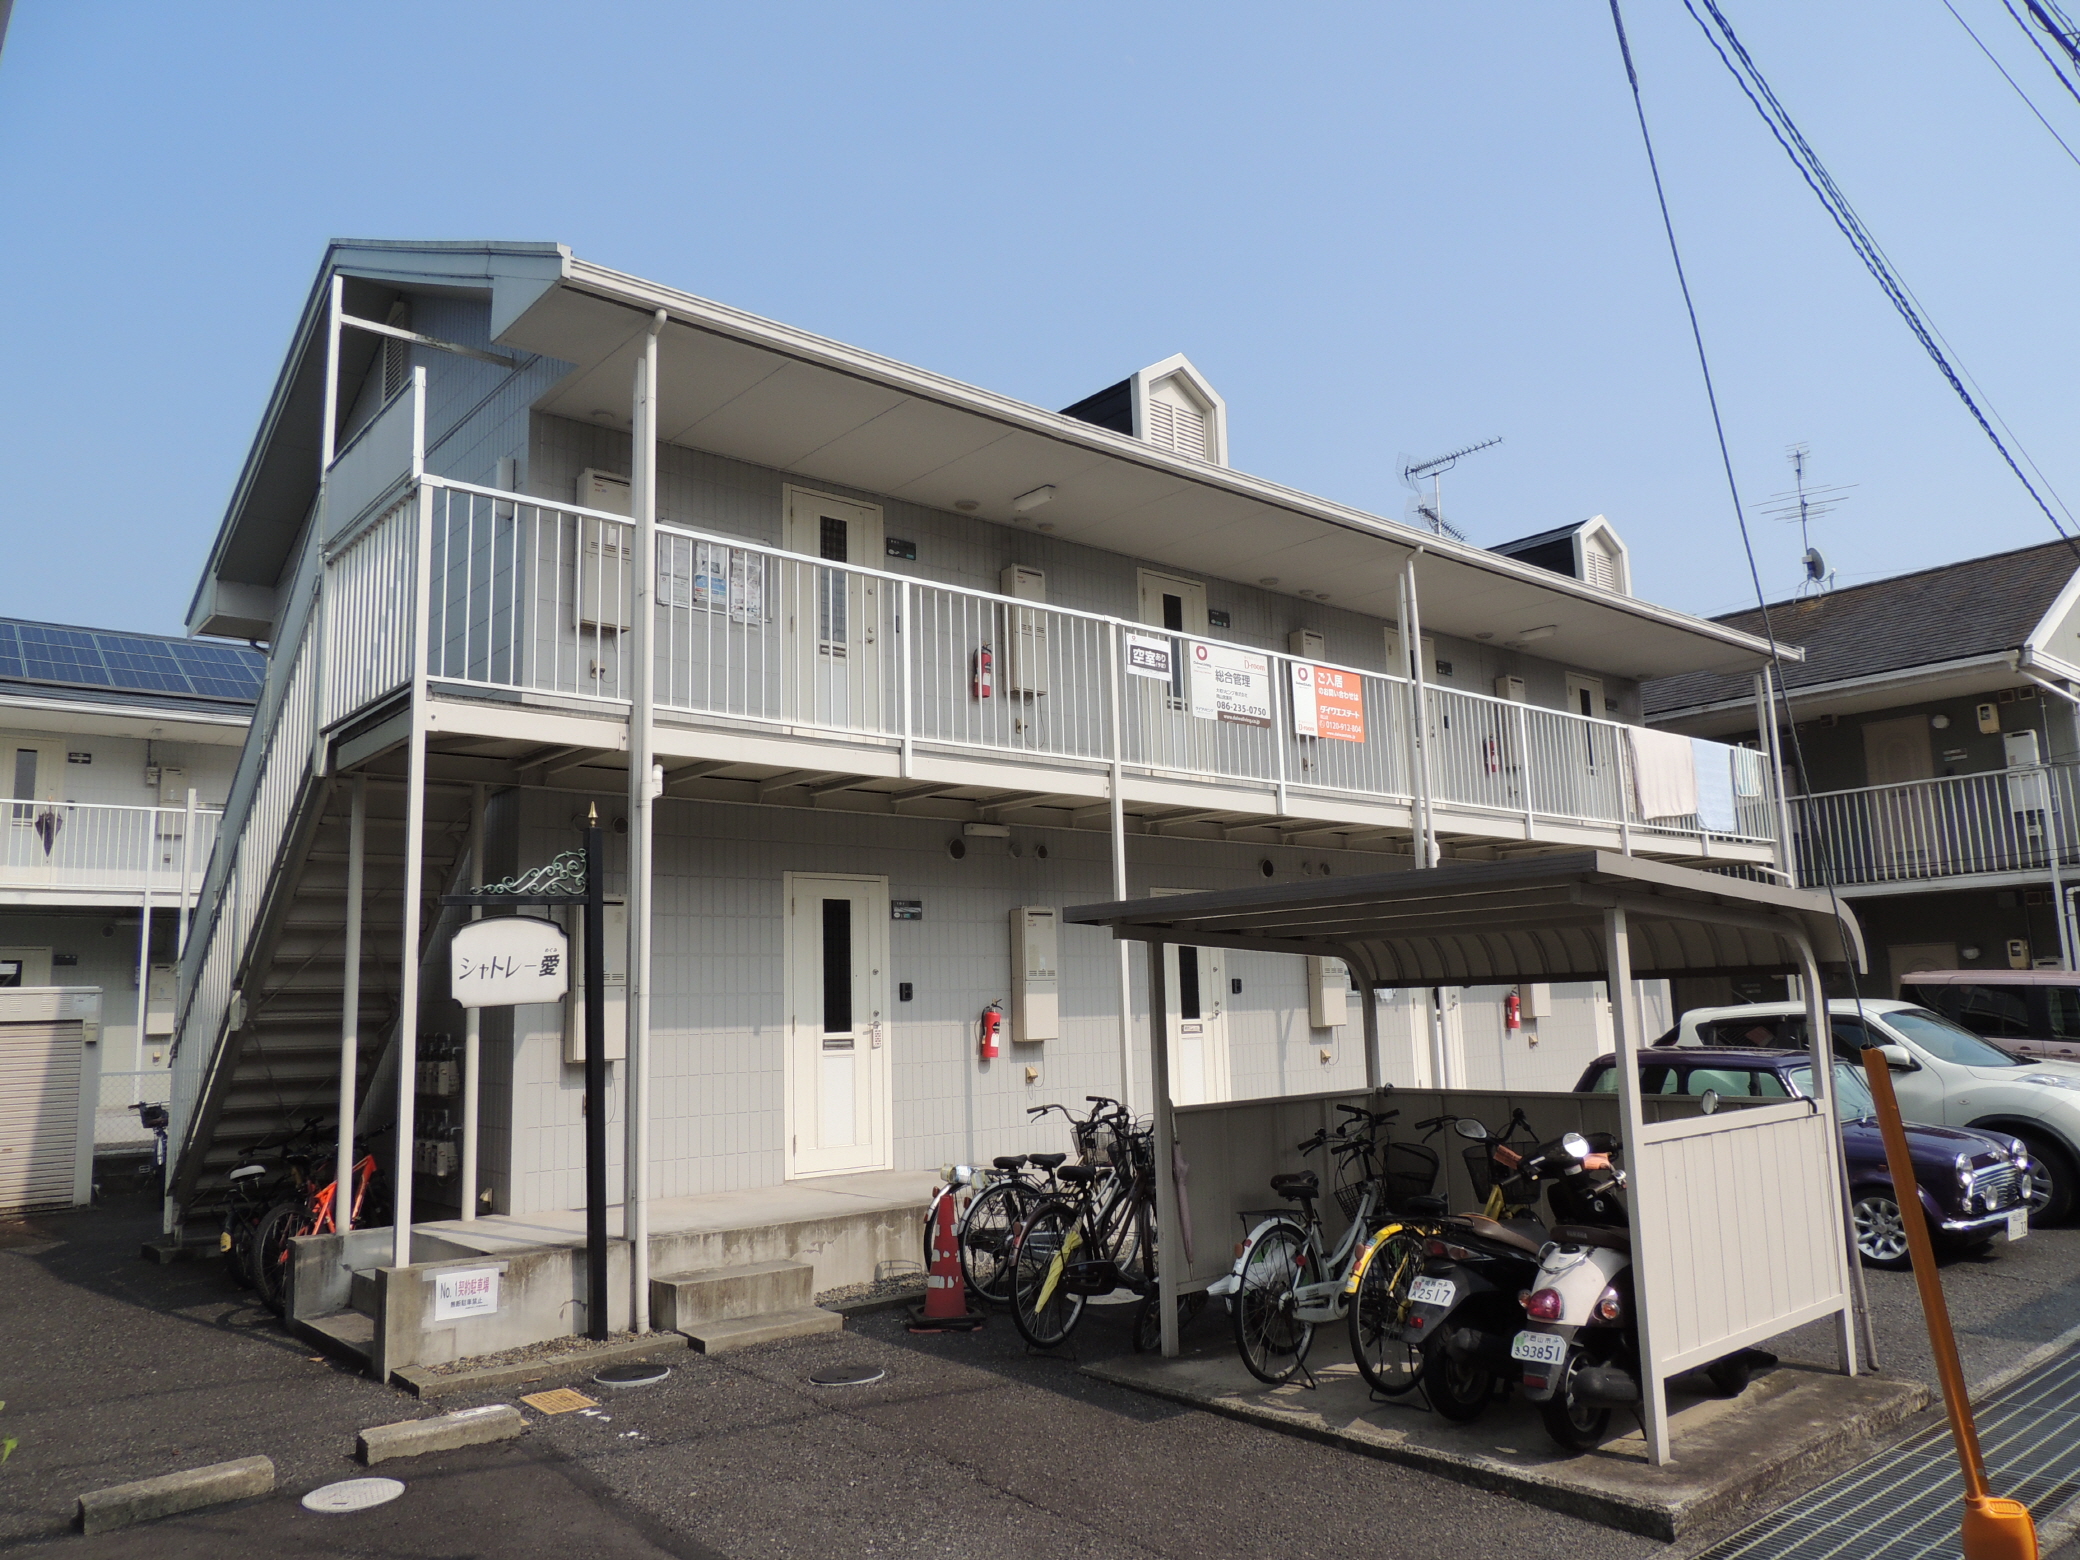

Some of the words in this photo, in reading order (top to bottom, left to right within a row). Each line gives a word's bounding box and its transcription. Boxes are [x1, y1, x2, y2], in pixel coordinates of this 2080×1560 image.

[1132, 648, 1167, 667] 空室あり
[1244, 659, 1266, 672] D-room
[1215, 669, 1251, 688] 総合管理
[1317, 671, 1343, 688] ご入居
[1318, 688, 1359, 702] のお問い合わせは
[1216, 700, 1267, 716] 086-235-0750
[1319, 705, 1360, 719] ダイワエステート
[1326, 720, 1362, 733] 0120-912-804
[458, 953, 560, 980] シャトレー愛
[450, 1297, 484, 1308] 無断駐車禁止
[1417, 1288, 1451, 1303] 2517
[1521, 1345, 1561, 1362] 93851
